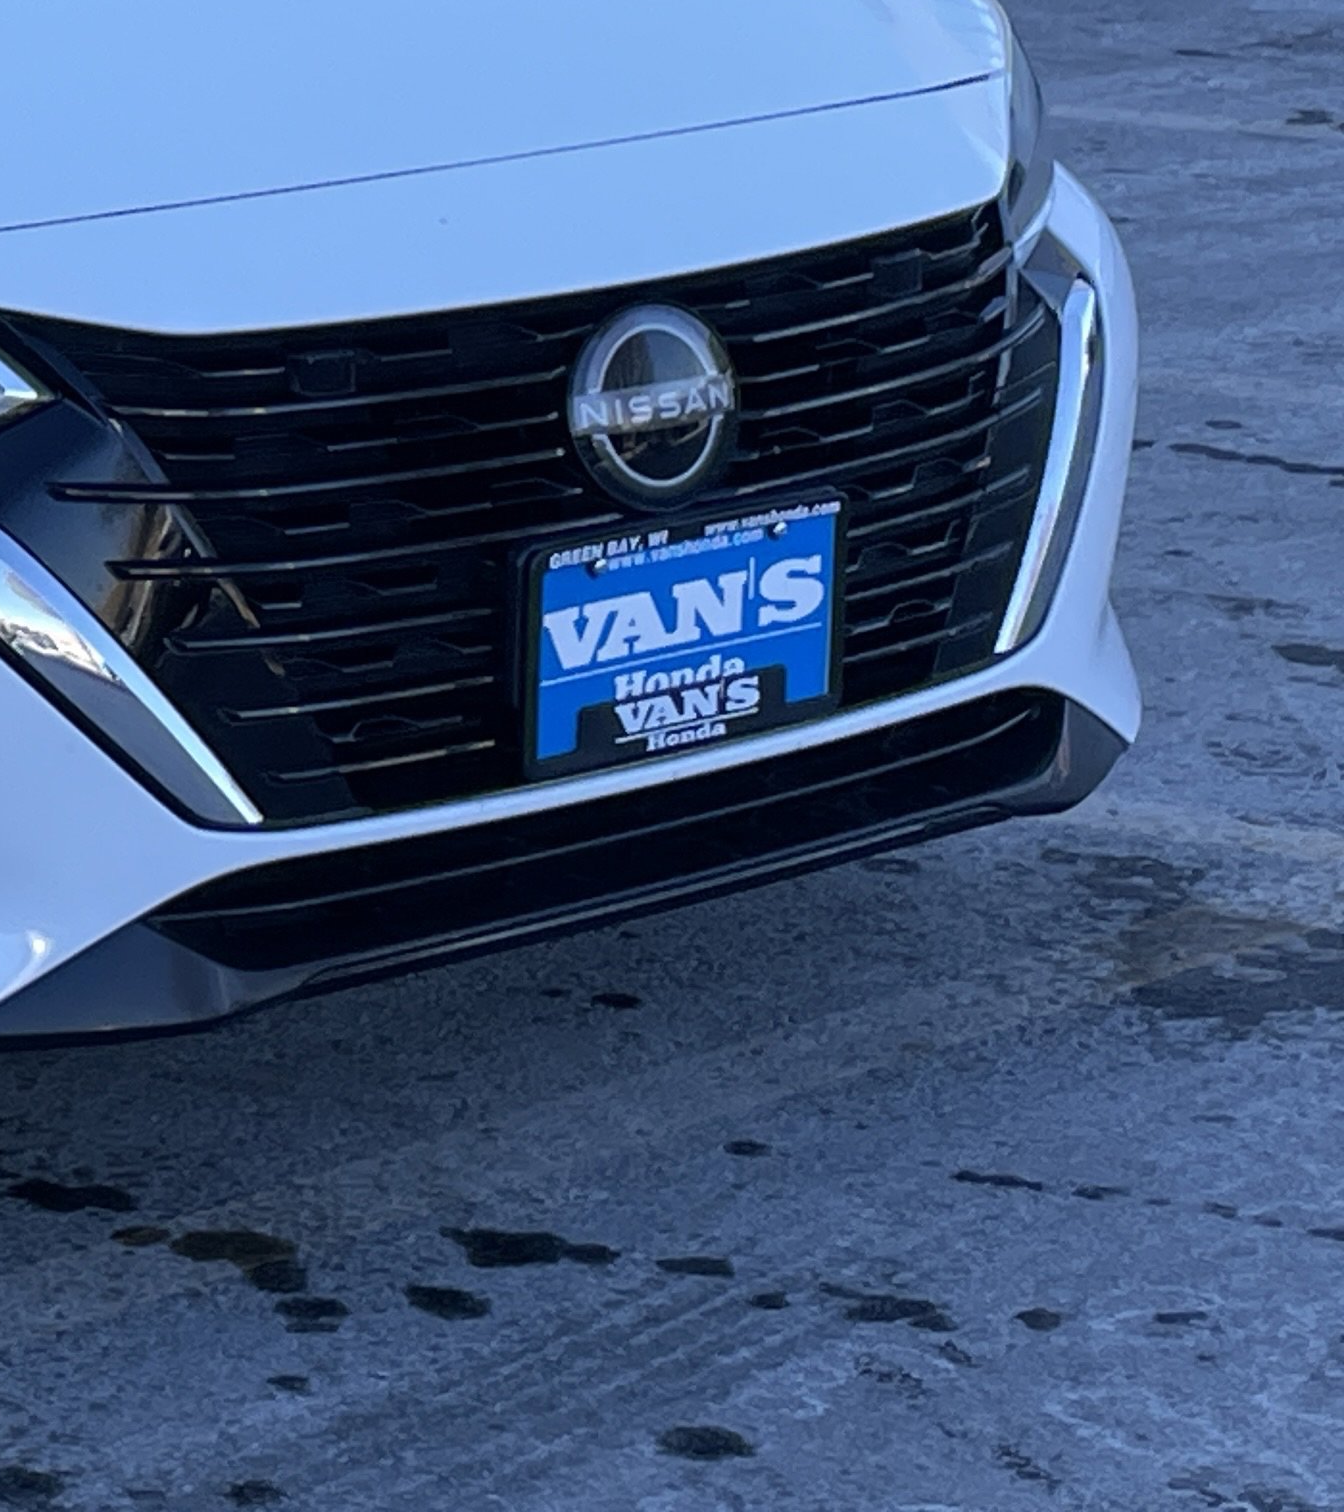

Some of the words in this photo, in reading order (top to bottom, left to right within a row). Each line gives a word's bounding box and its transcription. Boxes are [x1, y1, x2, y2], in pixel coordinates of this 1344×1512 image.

[575, 381, 730, 431] NISSAN
[549, 541, 603, 569] GREEN
[606, 534, 644, 557] BAY,
[648, 529, 670, 548] WI
[704, 500, 842, 536] www.vanshonda.com
[607, 528, 765, 572] www.vanshonda.com
[543, 554, 825, 670] VAN'S
[614, 654, 745, 701] Honda
[645, 721, 728, 752] Honda
